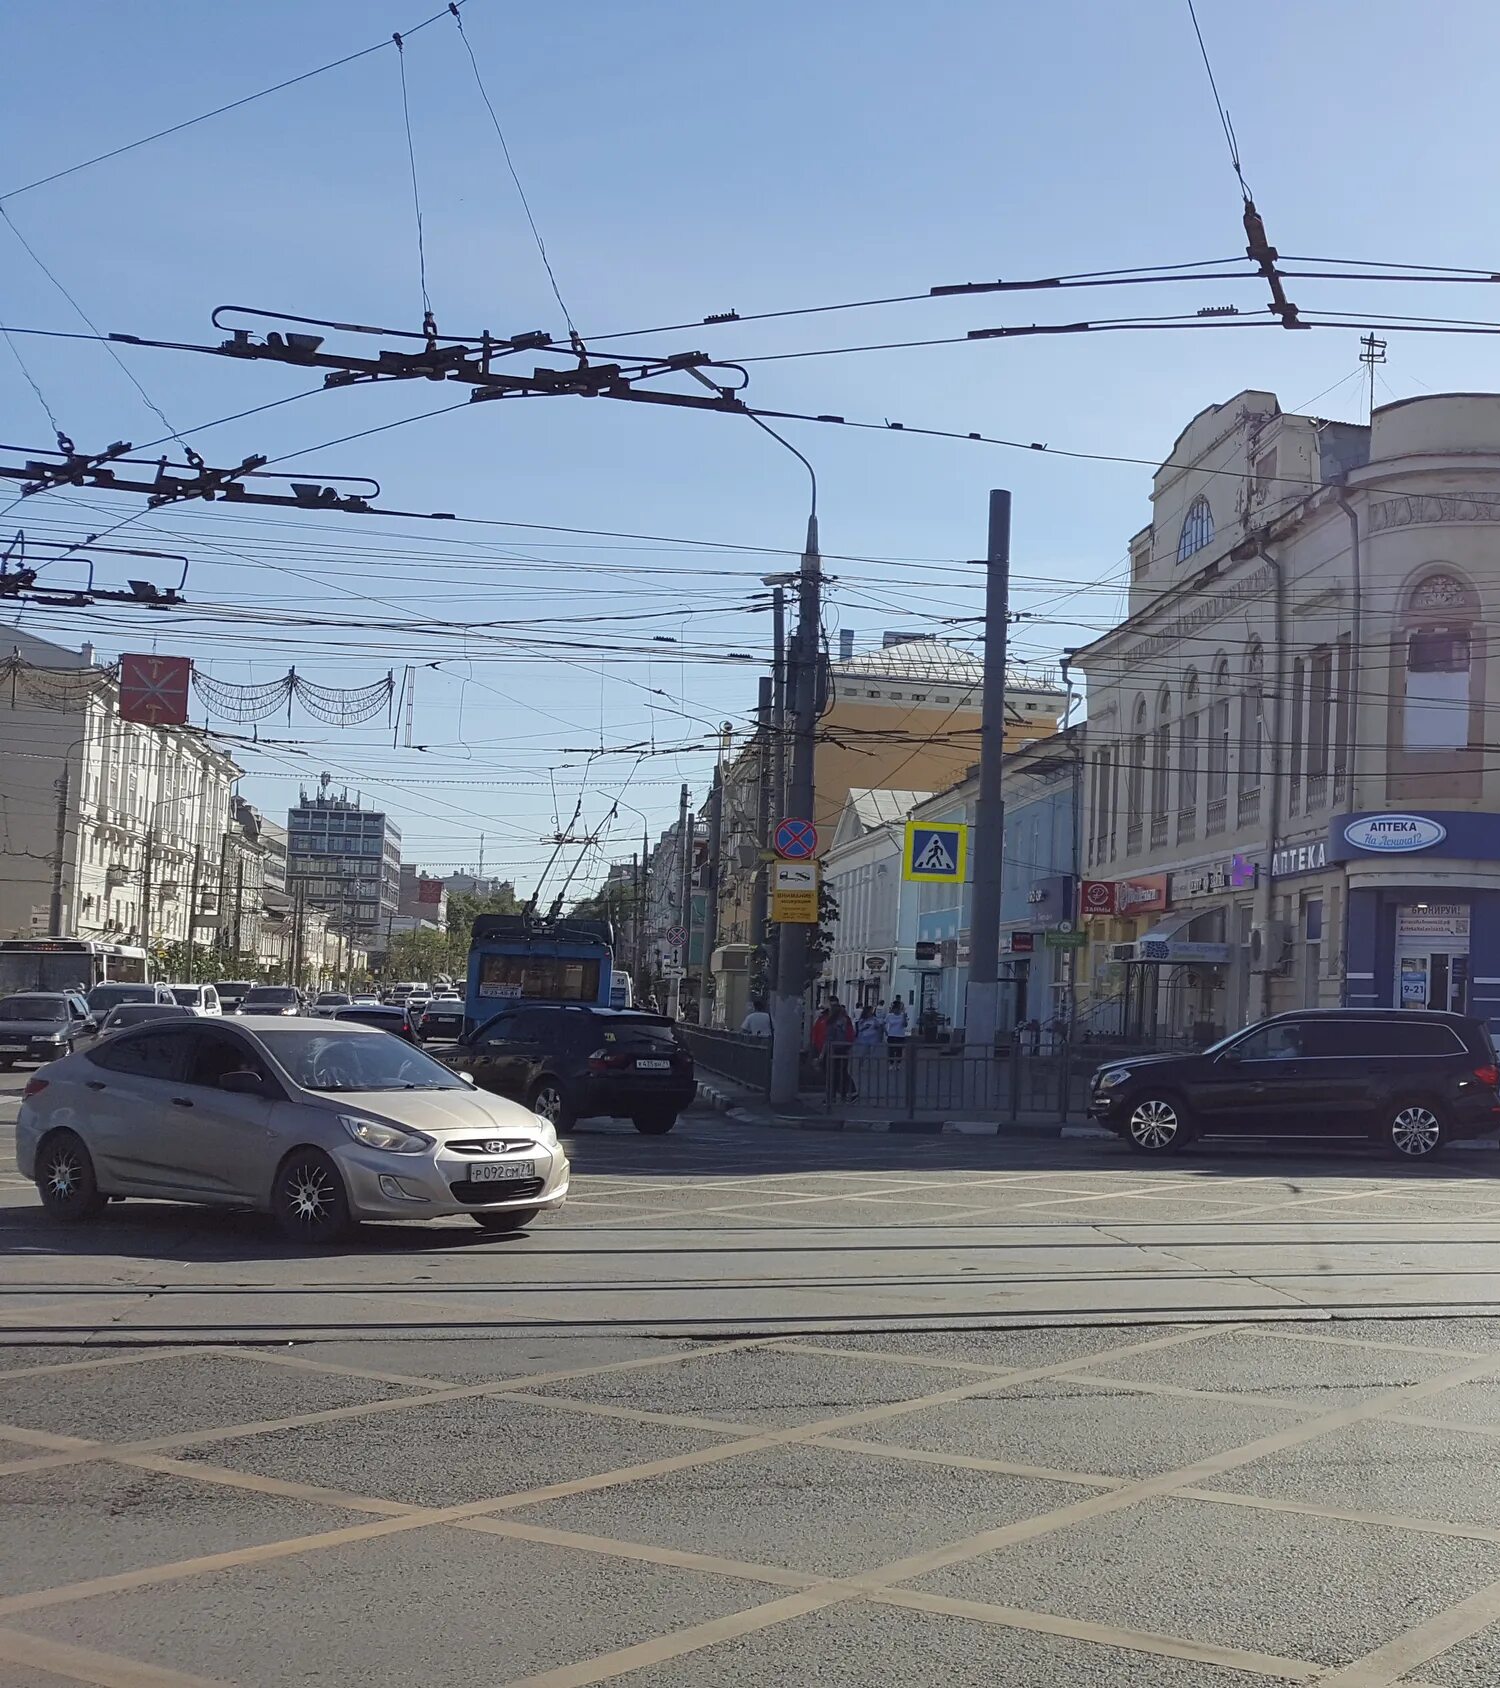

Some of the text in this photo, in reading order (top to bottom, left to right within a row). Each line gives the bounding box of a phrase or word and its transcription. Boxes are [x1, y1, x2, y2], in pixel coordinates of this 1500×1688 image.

[1370, 821, 1417, 832] АПТЕКА
[1364, 833, 1377, 846] На
[1271, 842, 1326, 877] АПТЕКА
[1403, 985, 1424, 994] 9-21
